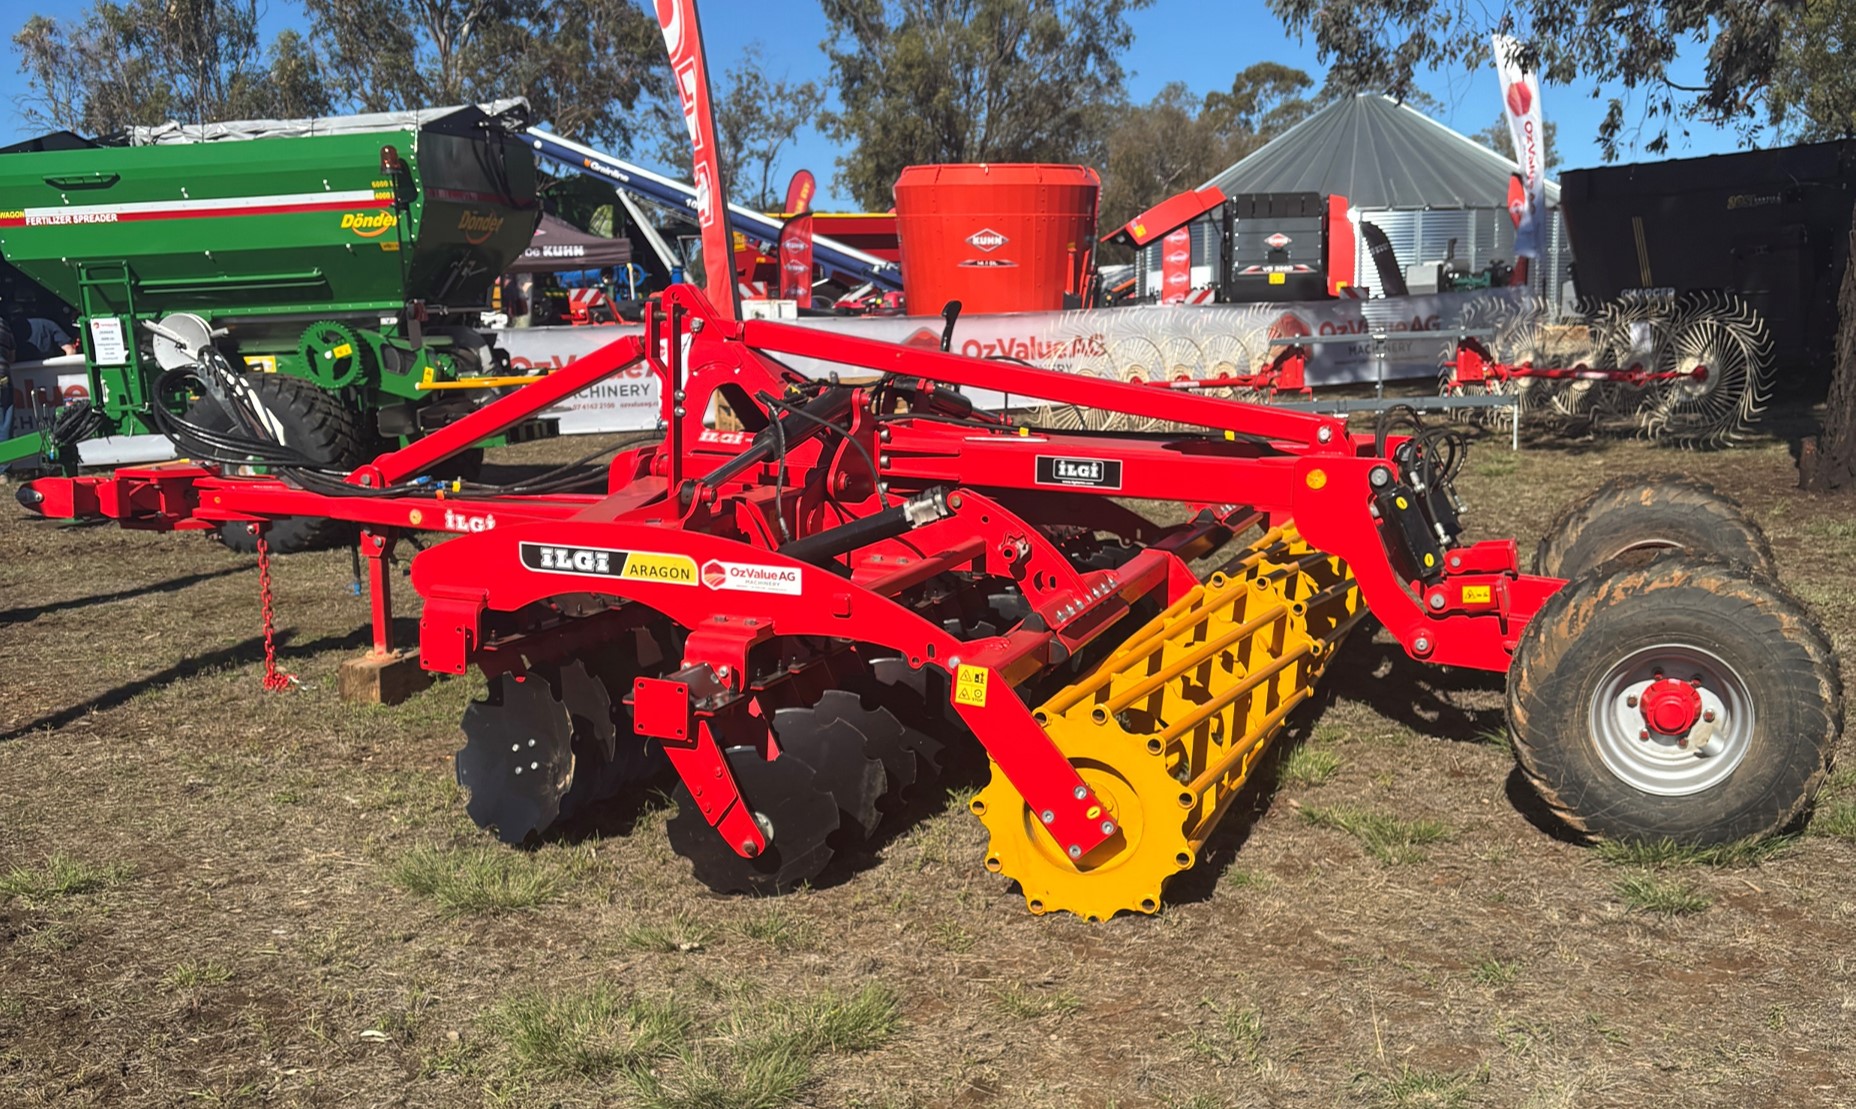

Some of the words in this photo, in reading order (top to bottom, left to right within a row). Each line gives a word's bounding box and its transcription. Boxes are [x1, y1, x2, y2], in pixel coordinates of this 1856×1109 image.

[25, 216, 72, 226] FERTILIZER
[73, 213, 119, 224] SPREADER
[972, 235, 1003, 246] KUHN
[543, 244, 585, 257] KUHN
[629, 564, 690, 580] ARAGON
[730, 567, 778, 581] OzValue
[778, 571, 796, 582] AG
